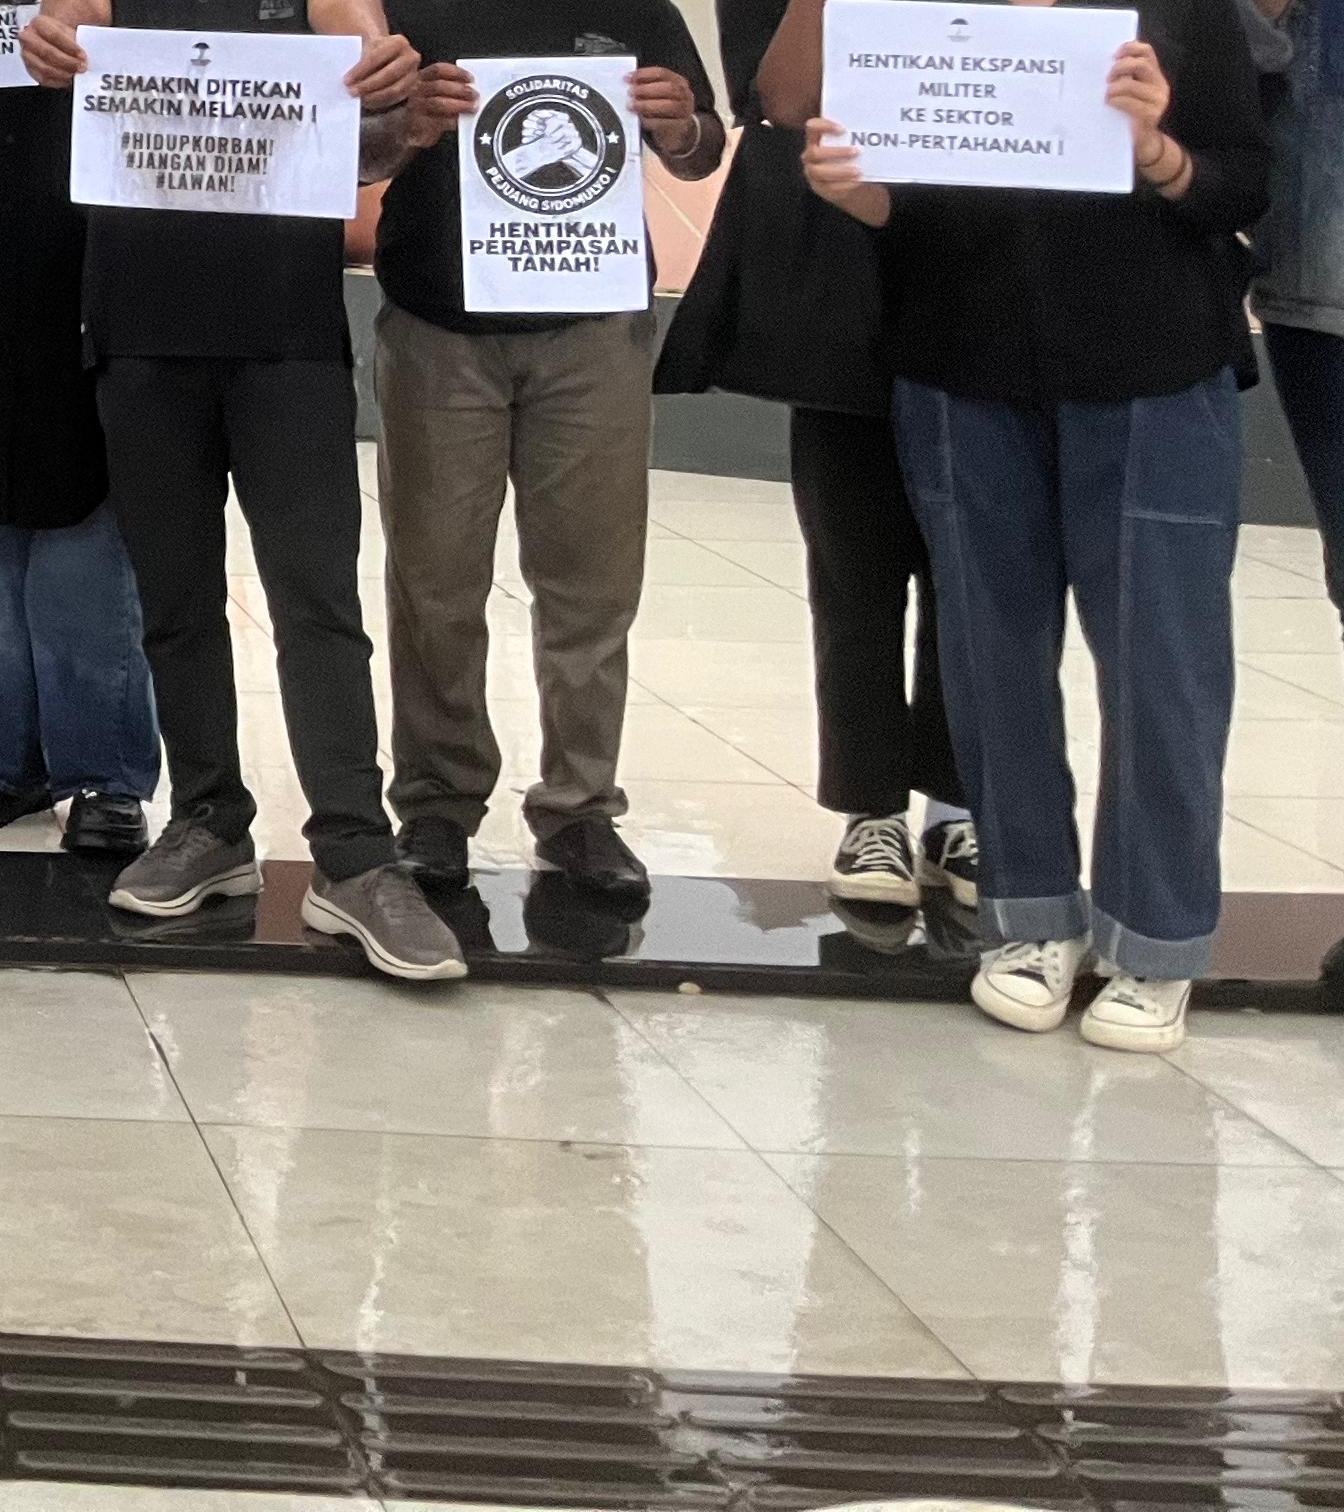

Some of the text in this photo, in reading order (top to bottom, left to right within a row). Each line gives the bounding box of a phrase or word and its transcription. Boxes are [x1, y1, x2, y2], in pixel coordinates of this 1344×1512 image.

[848, 53, 1065, 75] HENTIKAN EKSPANSI
[100, 73, 302, 99] SEMAKIN DITEKAN
[505, 78, 590, 100] SOLIDARITAS
[918, 81, 997, 99] MILITER
[83, 94, 182, 116] SEMAKIN
[188, 100, 303, 122] MELAWAN
[900, 107, 1014, 126] KE SEKTOR
[121, 131, 274, 156] #HIDUPKORBAN!
[850, 131, 1052, 155] NON-PERTAHANAN
[126, 152, 268, 175] #JANGAN DIAM!
[156, 172, 235, 193] #LAWAN!
[485, 166, 540, 211] PEJUANG
[540, 174, 612, 212] SIDOMULYO
[489, 222, 617, 238] HENTIKAN
[469, 239, 638, 255] PERAMPASAN
[508, 256, 599, 272] TANAH!
